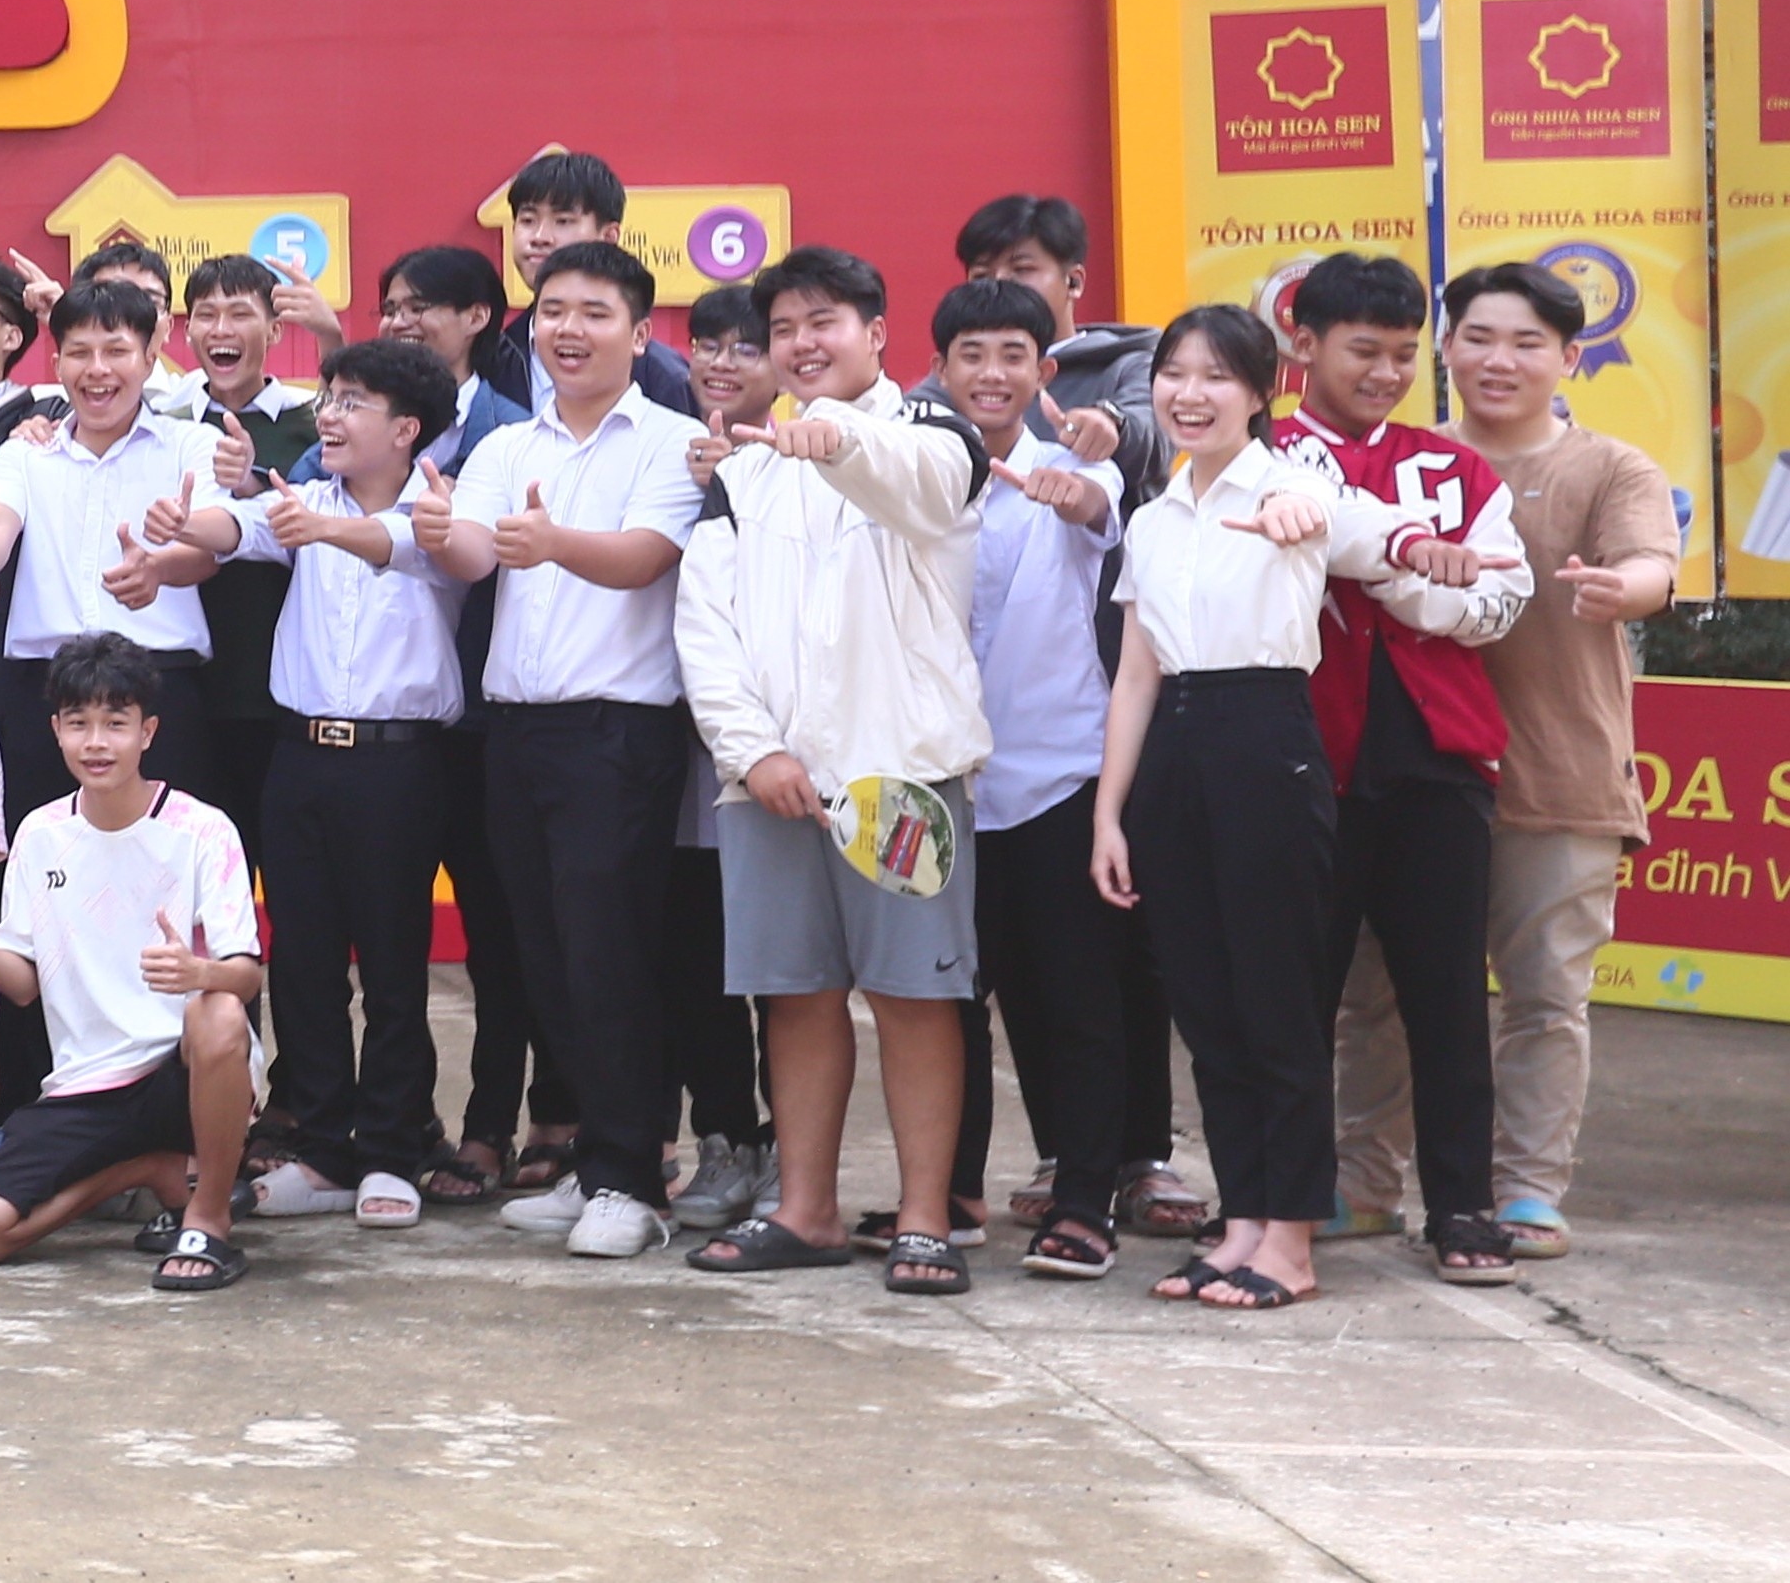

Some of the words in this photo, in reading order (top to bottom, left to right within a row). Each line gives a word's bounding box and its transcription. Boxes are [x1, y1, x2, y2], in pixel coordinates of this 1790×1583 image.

[1225, 115, 1272, 140] TÔN
[1280, 117, 1329, 137] HOA
[1335, 114, 1381, 134] SEN
[1586, 108, 1622, 124] HOA
[1626, 107, 1661, 124] SEN
[1200, 216, 1265, 248] TÔN
[1276, 221, 1342, 244] HOA
[1352, 219, 1415, 241] SEN
[1458, 203, 1510, 229] ỐNG
[1518, 207, 1587, 232] NHỰA
[1595, 209, 1646, 228] HOA
[1653, 207, 1702, 226] SEN
[155, 235, 182, 256] Mái
[276, 230, 308, 270] 5
[652, 245, 681, 269] Việt
[710, 220, 746, 267] 6
[1646, 848, 1753, 901] đình
